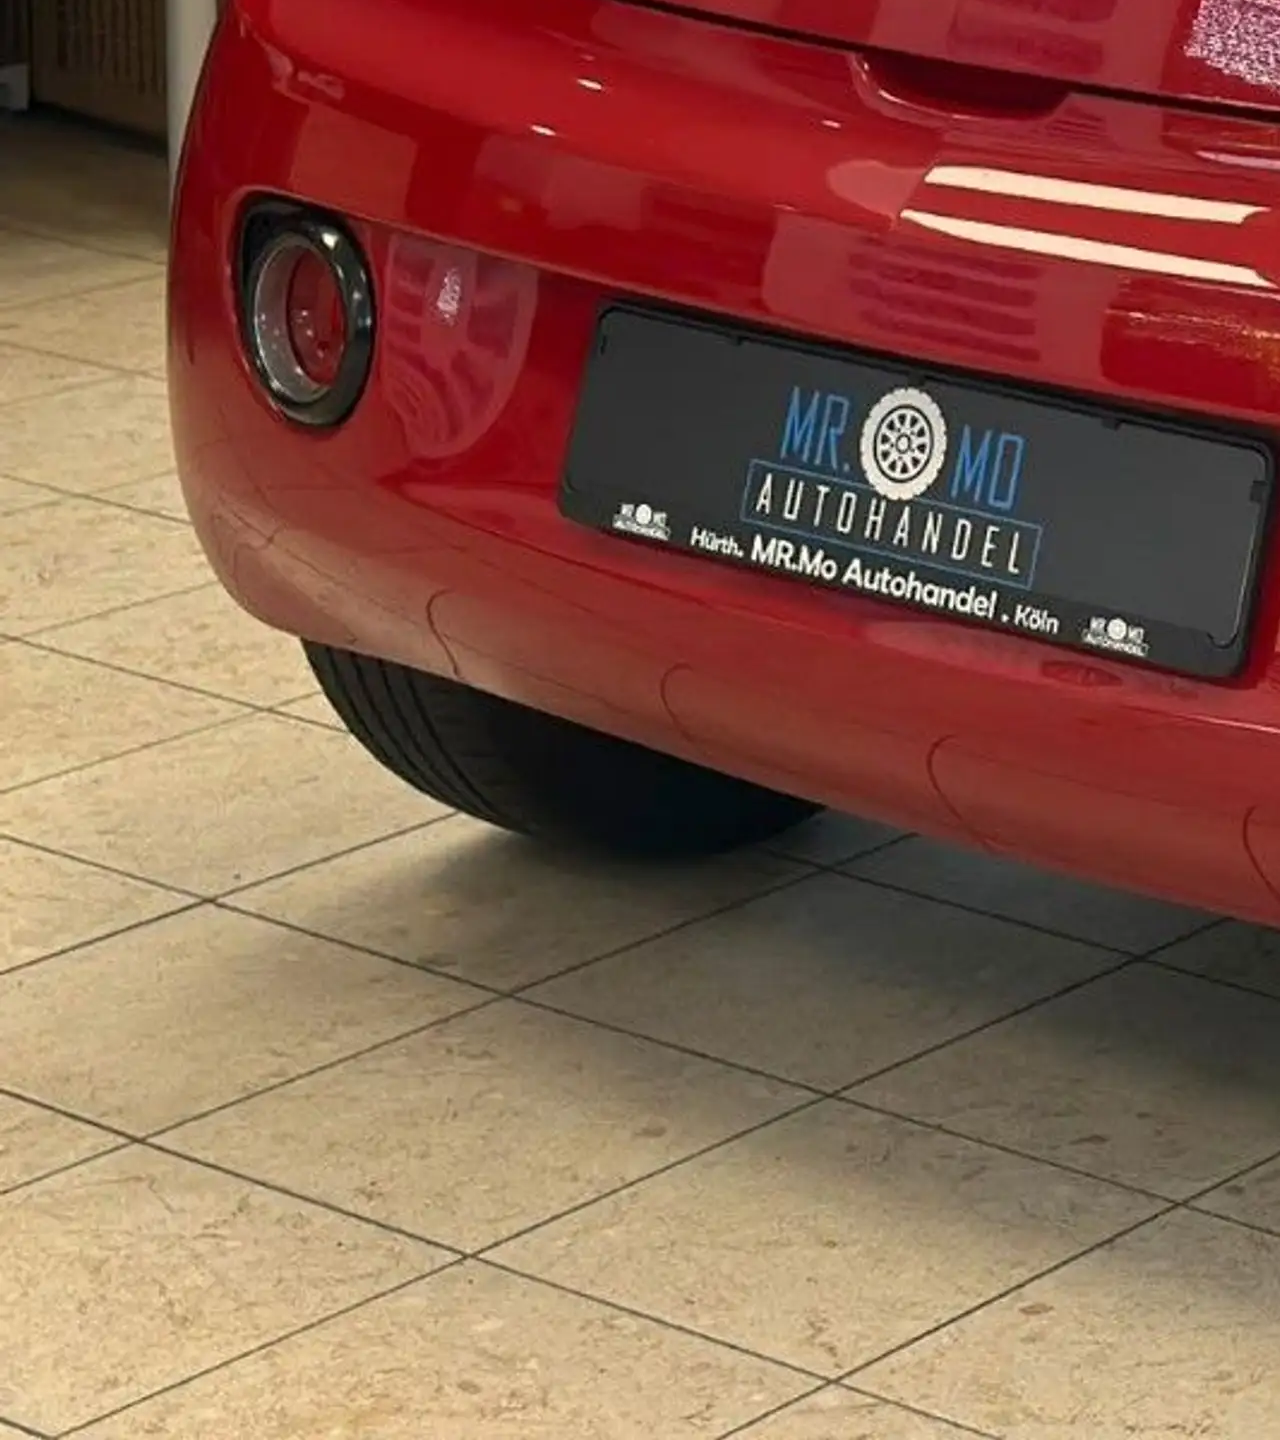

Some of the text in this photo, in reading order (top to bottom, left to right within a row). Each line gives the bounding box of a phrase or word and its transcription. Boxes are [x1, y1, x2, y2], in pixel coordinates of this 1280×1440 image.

[951, 424, 1025, 510] MO
[755, 472, 1022, 574] AUTOHANDEL
[751, 534, 837, 581] MR.Mo
[842, 558, 998, 622] Autohandel
[1014, 604, 1061, 635] Köln
